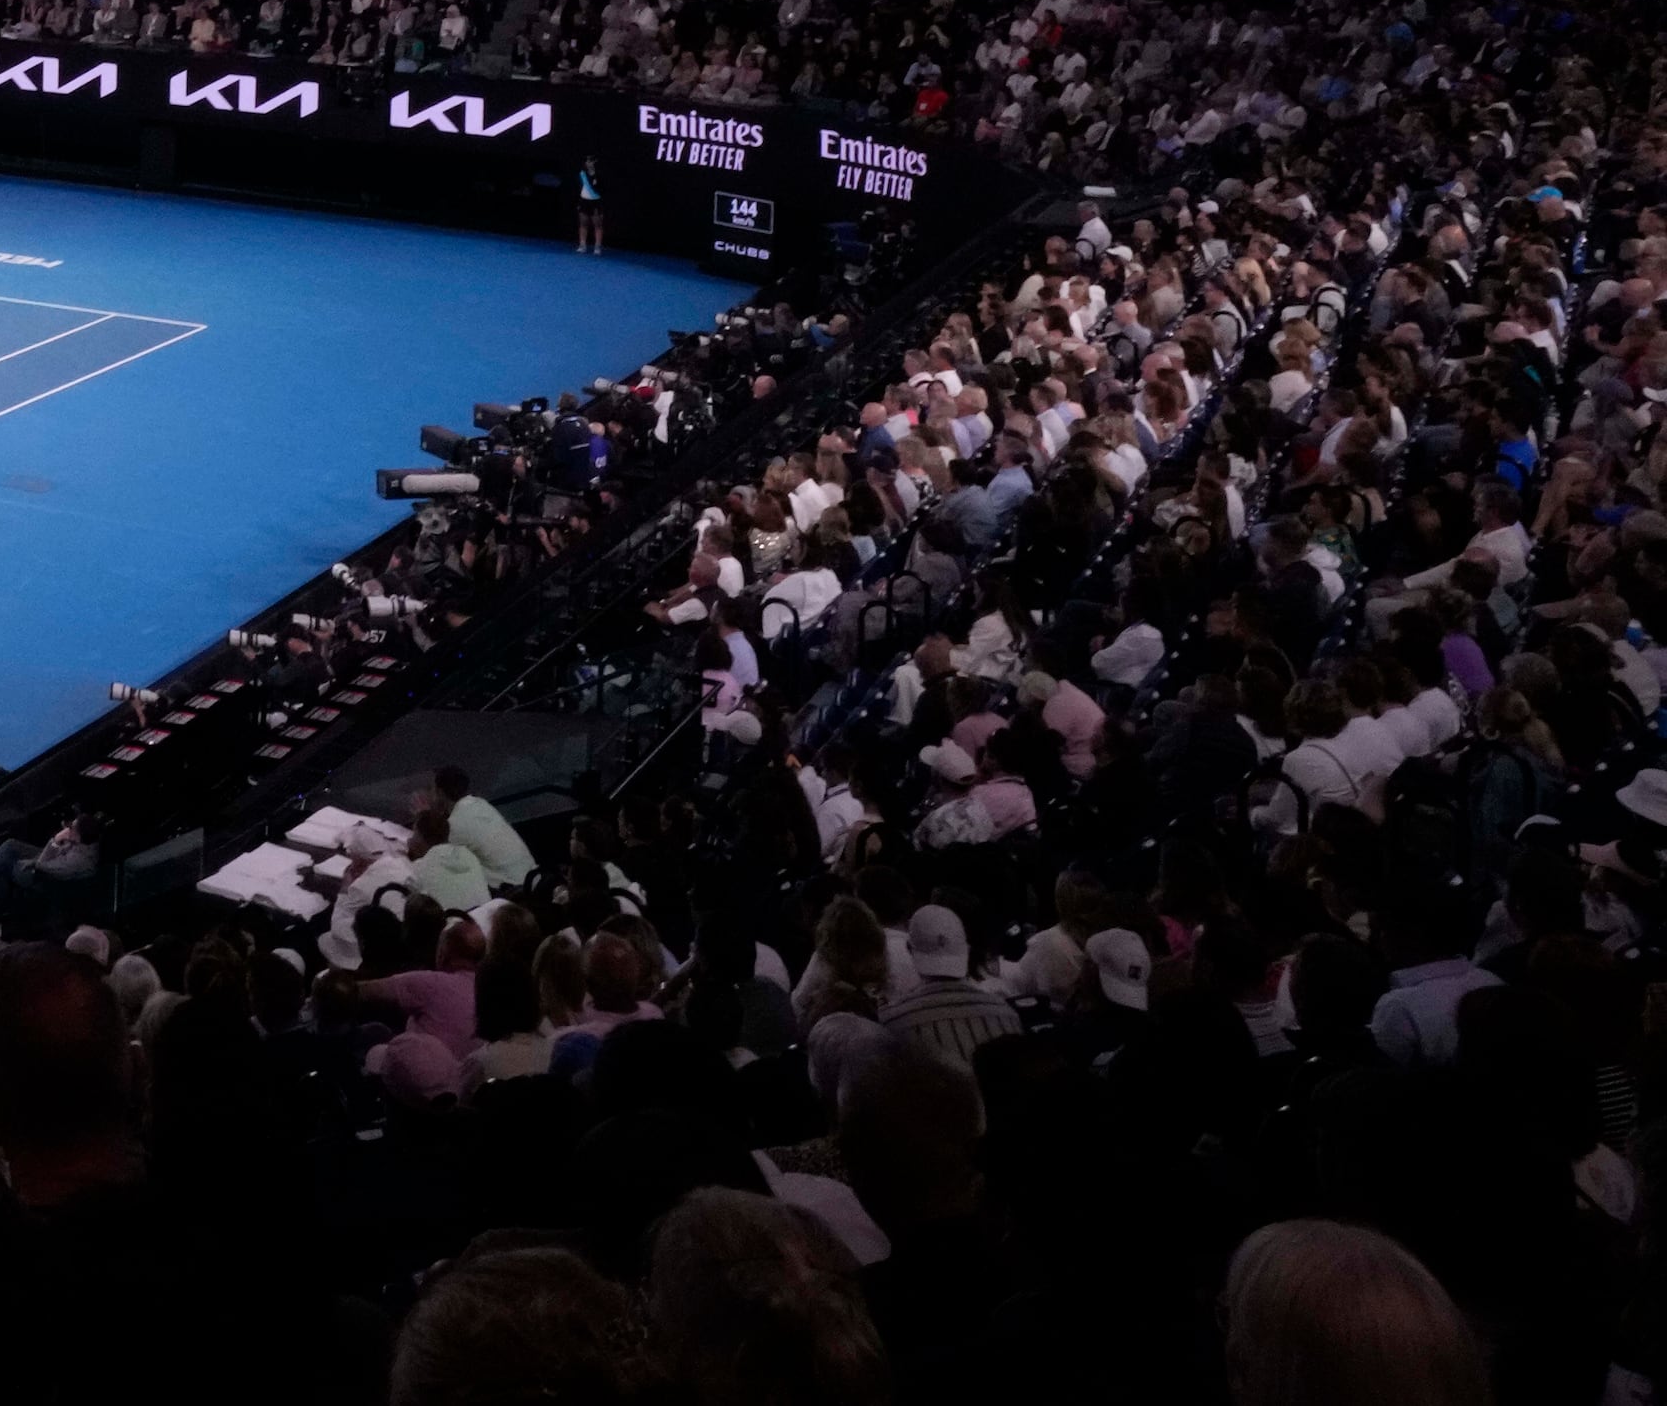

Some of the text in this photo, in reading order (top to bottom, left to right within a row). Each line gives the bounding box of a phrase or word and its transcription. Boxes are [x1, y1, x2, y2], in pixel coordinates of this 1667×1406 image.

[169, 70, 319, 118] KIA
[389, 90, 553, 142] KIA
[638, 105, 764, 148] Emirates
[657, 138, 746, 172] FLY BETTER
[819, 129, 928, 177] Emirates
[837, 164, 913, 202] FLY BETTER
[730, 198, 758, 218] 144
